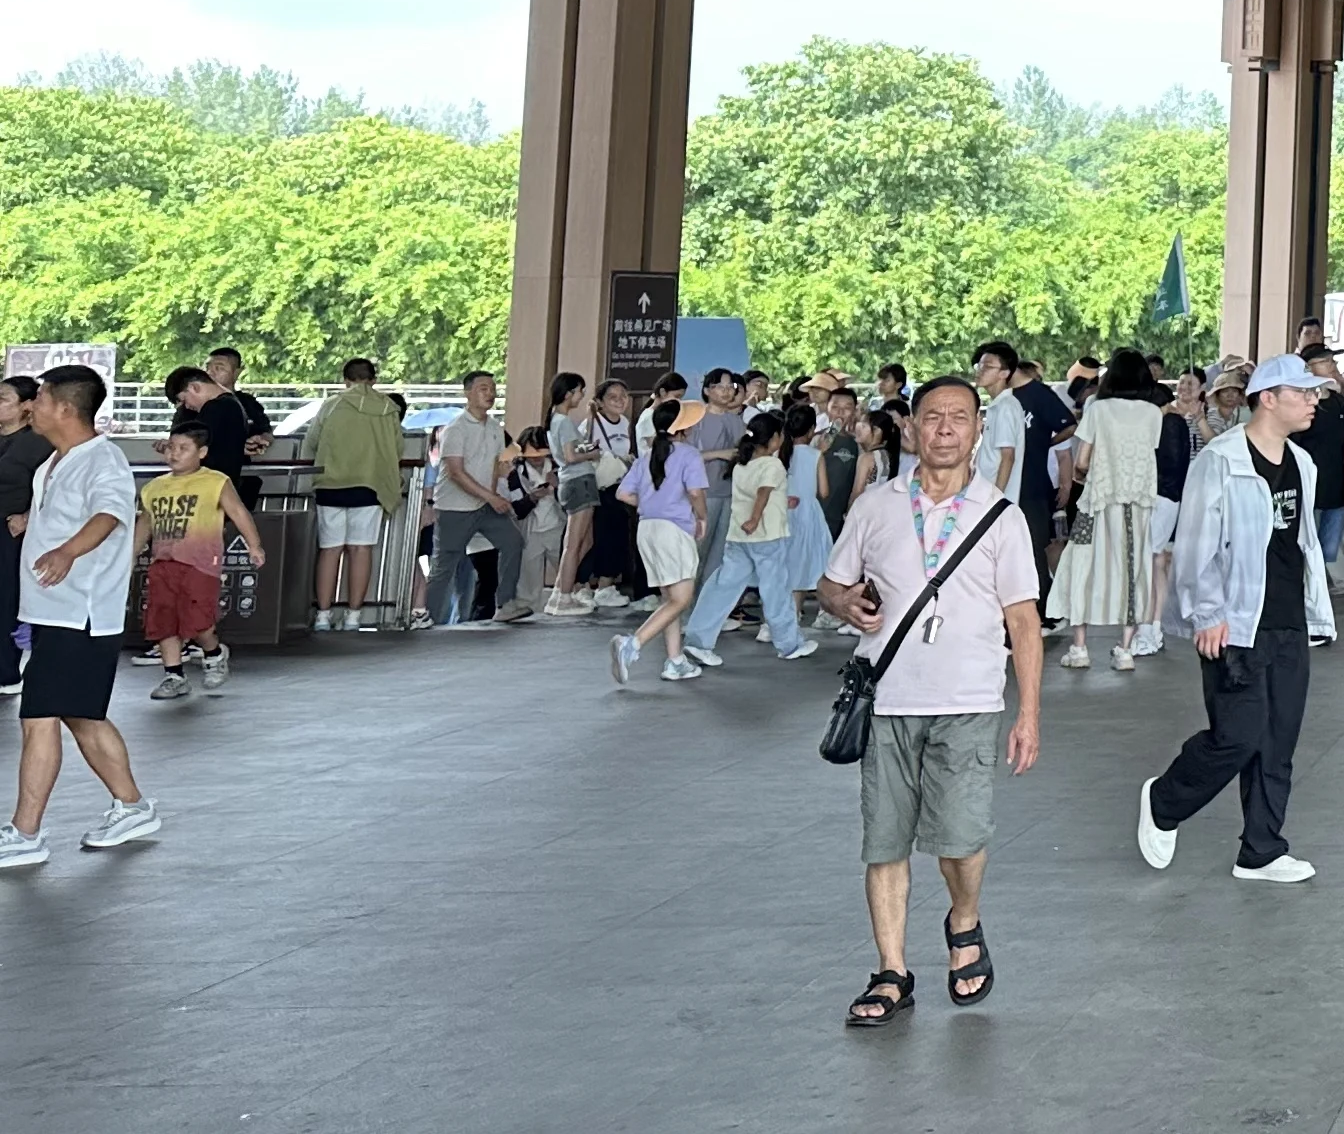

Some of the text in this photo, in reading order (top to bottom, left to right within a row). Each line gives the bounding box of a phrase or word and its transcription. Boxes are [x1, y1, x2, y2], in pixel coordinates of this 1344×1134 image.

[618, 335, 667, 349] 地下停车场
